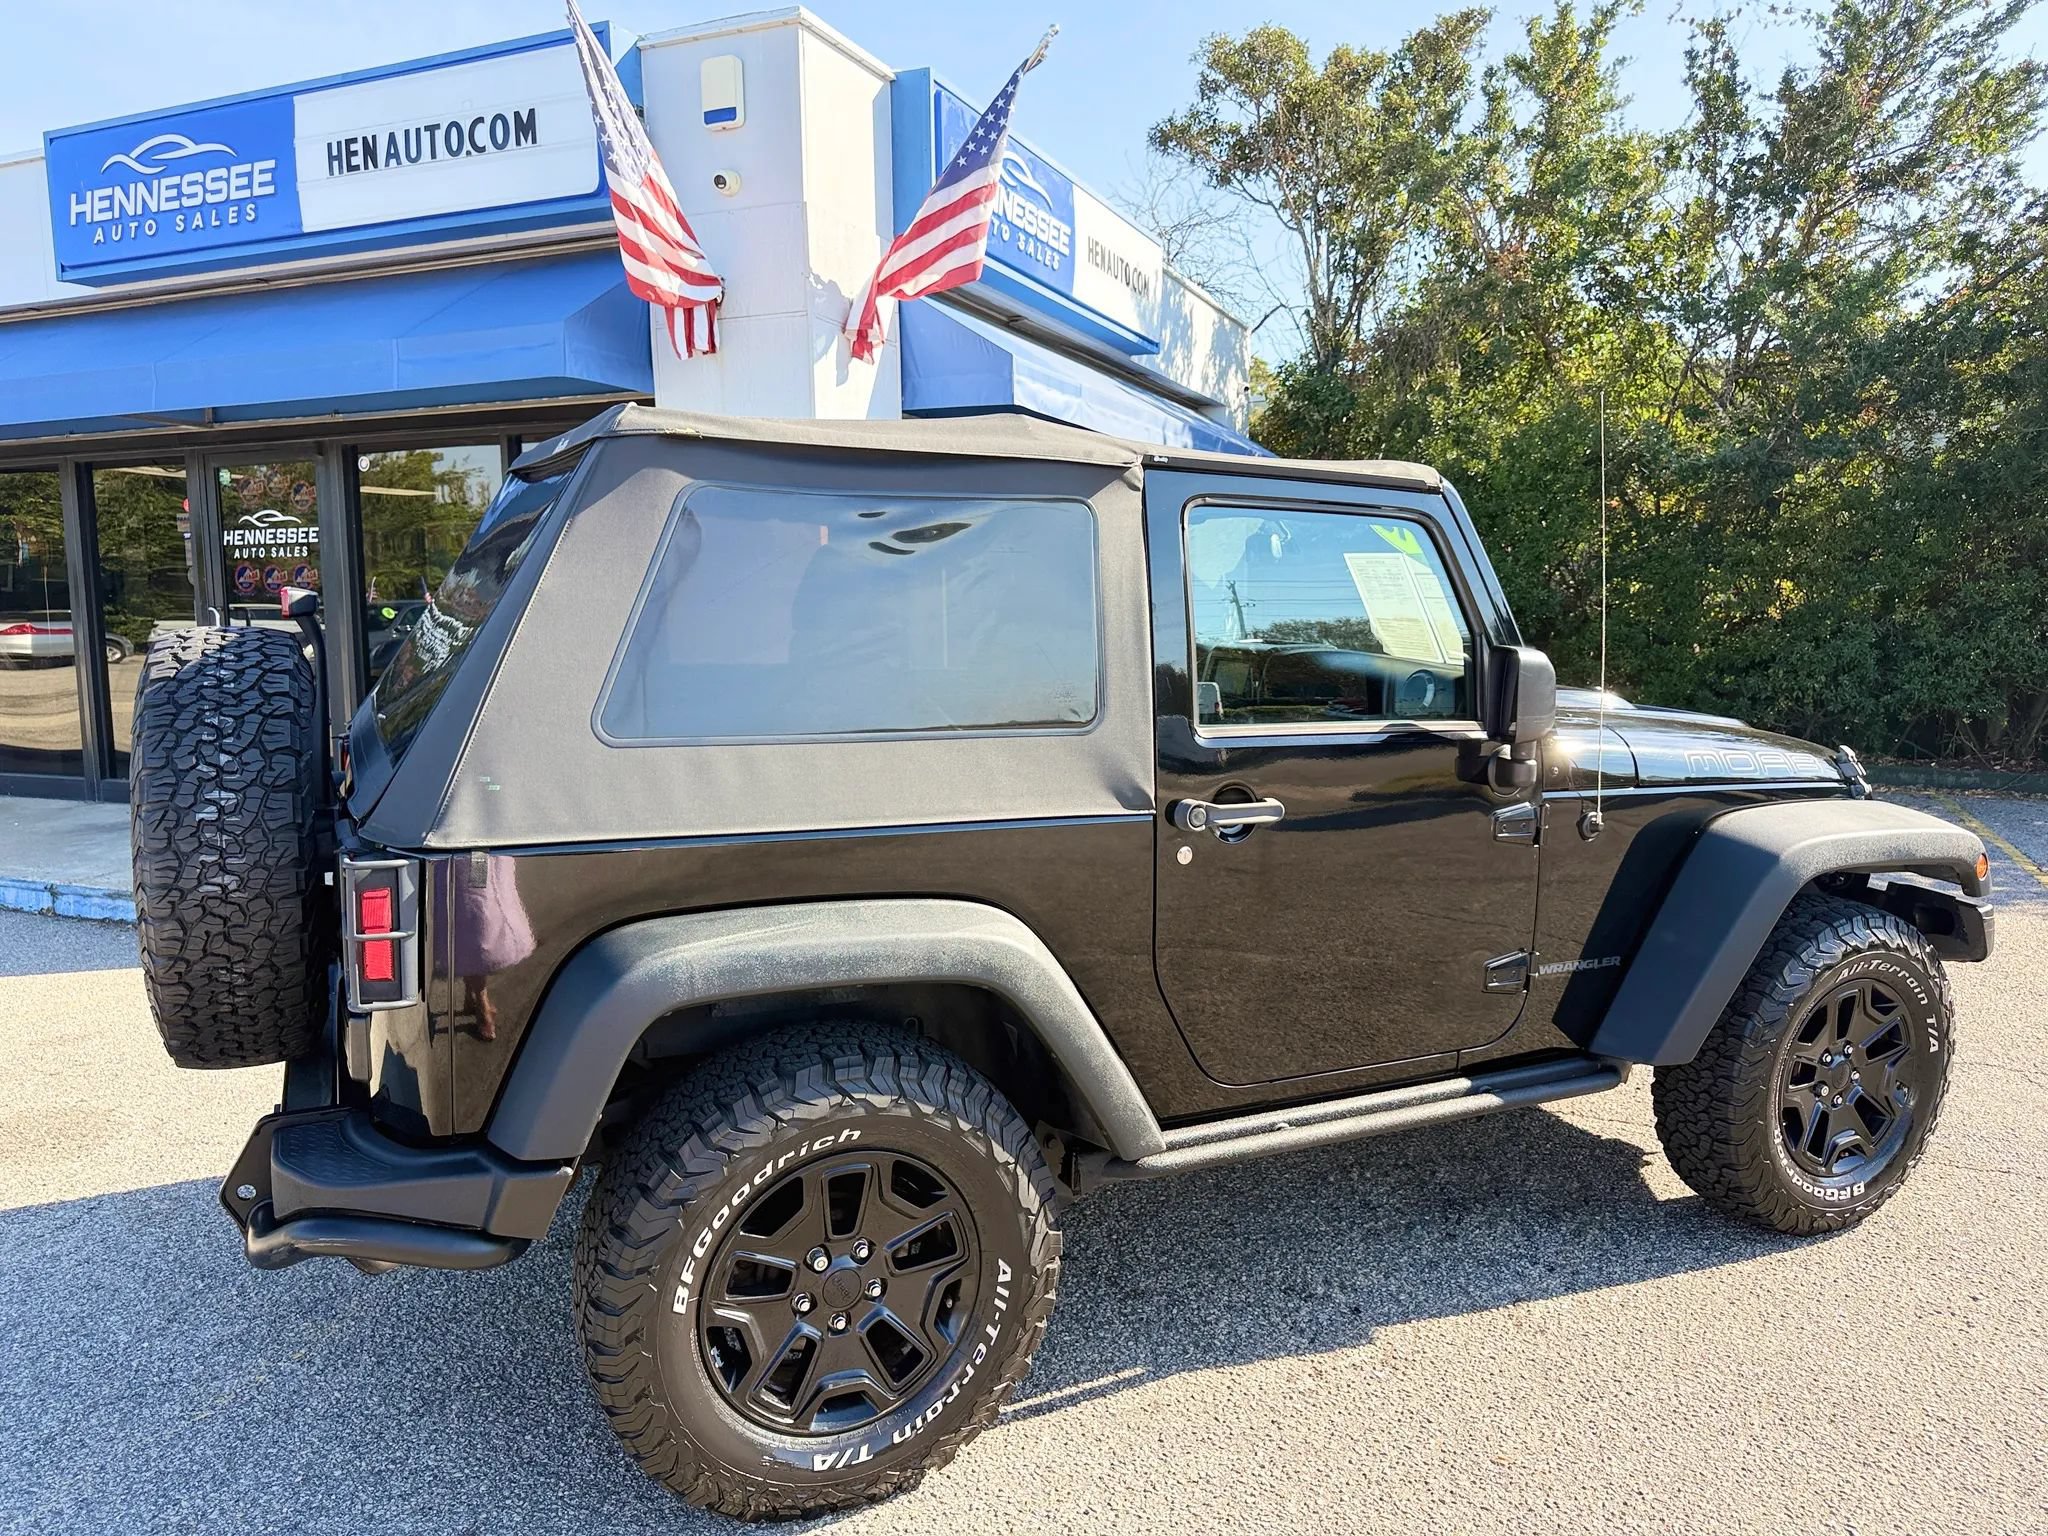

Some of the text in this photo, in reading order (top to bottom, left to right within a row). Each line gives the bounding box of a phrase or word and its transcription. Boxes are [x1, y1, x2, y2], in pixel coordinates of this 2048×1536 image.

[327, 108, 537, 176] HENAUTO.COM
[71, 159, 275, 226] HENNESSEE
[94, 203, 256, 244] AUTO SALES
[993, 184, 1071, 257] NESSEE
[991, 216, 1061, 271] TO SALES
[223, 527, 319, 546] HENNESSEE
[234, 546, 308, 559] AUTO SALES
[1539, 956, 1621, 975] WRANGLER
[1836, 960, 1939, 1053] All-Terrain T/A
[673, 1128, 861, 1315] BFGoodrich
[813, 1258, 1012, 1472] All-Terrain T/A
